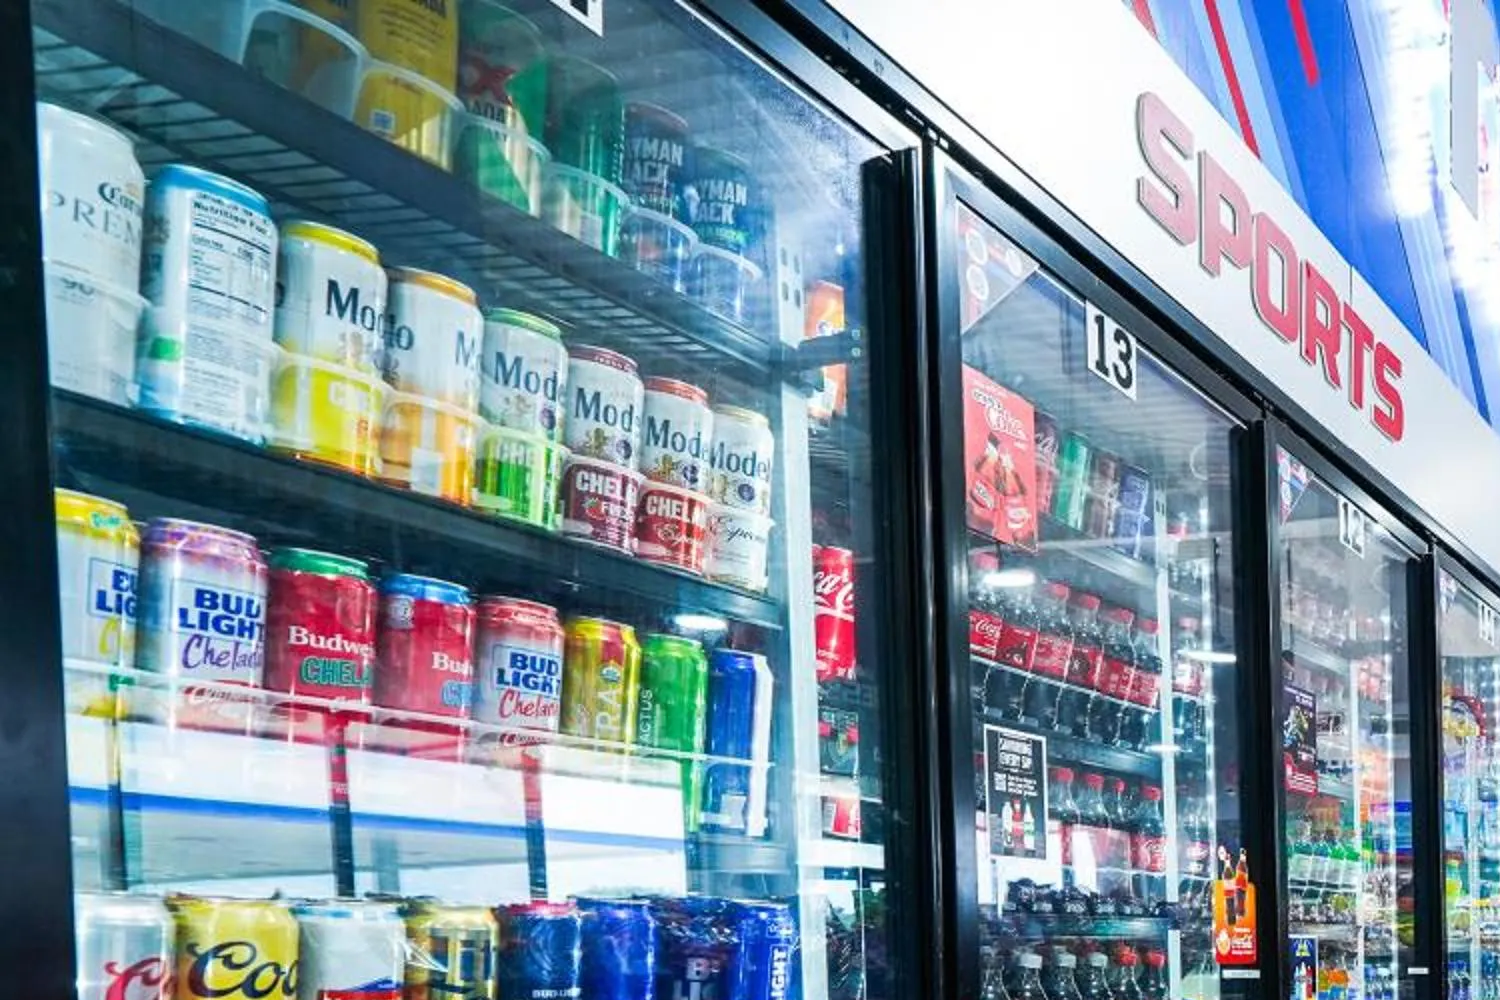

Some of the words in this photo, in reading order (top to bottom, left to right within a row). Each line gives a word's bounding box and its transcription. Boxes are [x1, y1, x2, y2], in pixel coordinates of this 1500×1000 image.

[626, 136, 684, 167] YMAN
[699, 179, 748, 207] YMAN
[193, 202, 248, 227] Nutrition
[1136, 91, 1405, 443] SPORTS
[1095, 314, 1135, 389] 13
[1342, 501, 1364, 555] 12
[193, 587, 262, 617] BUD
[508, 650, 560, 678] BUD
[631, 683, 654, 748] ACTUS
